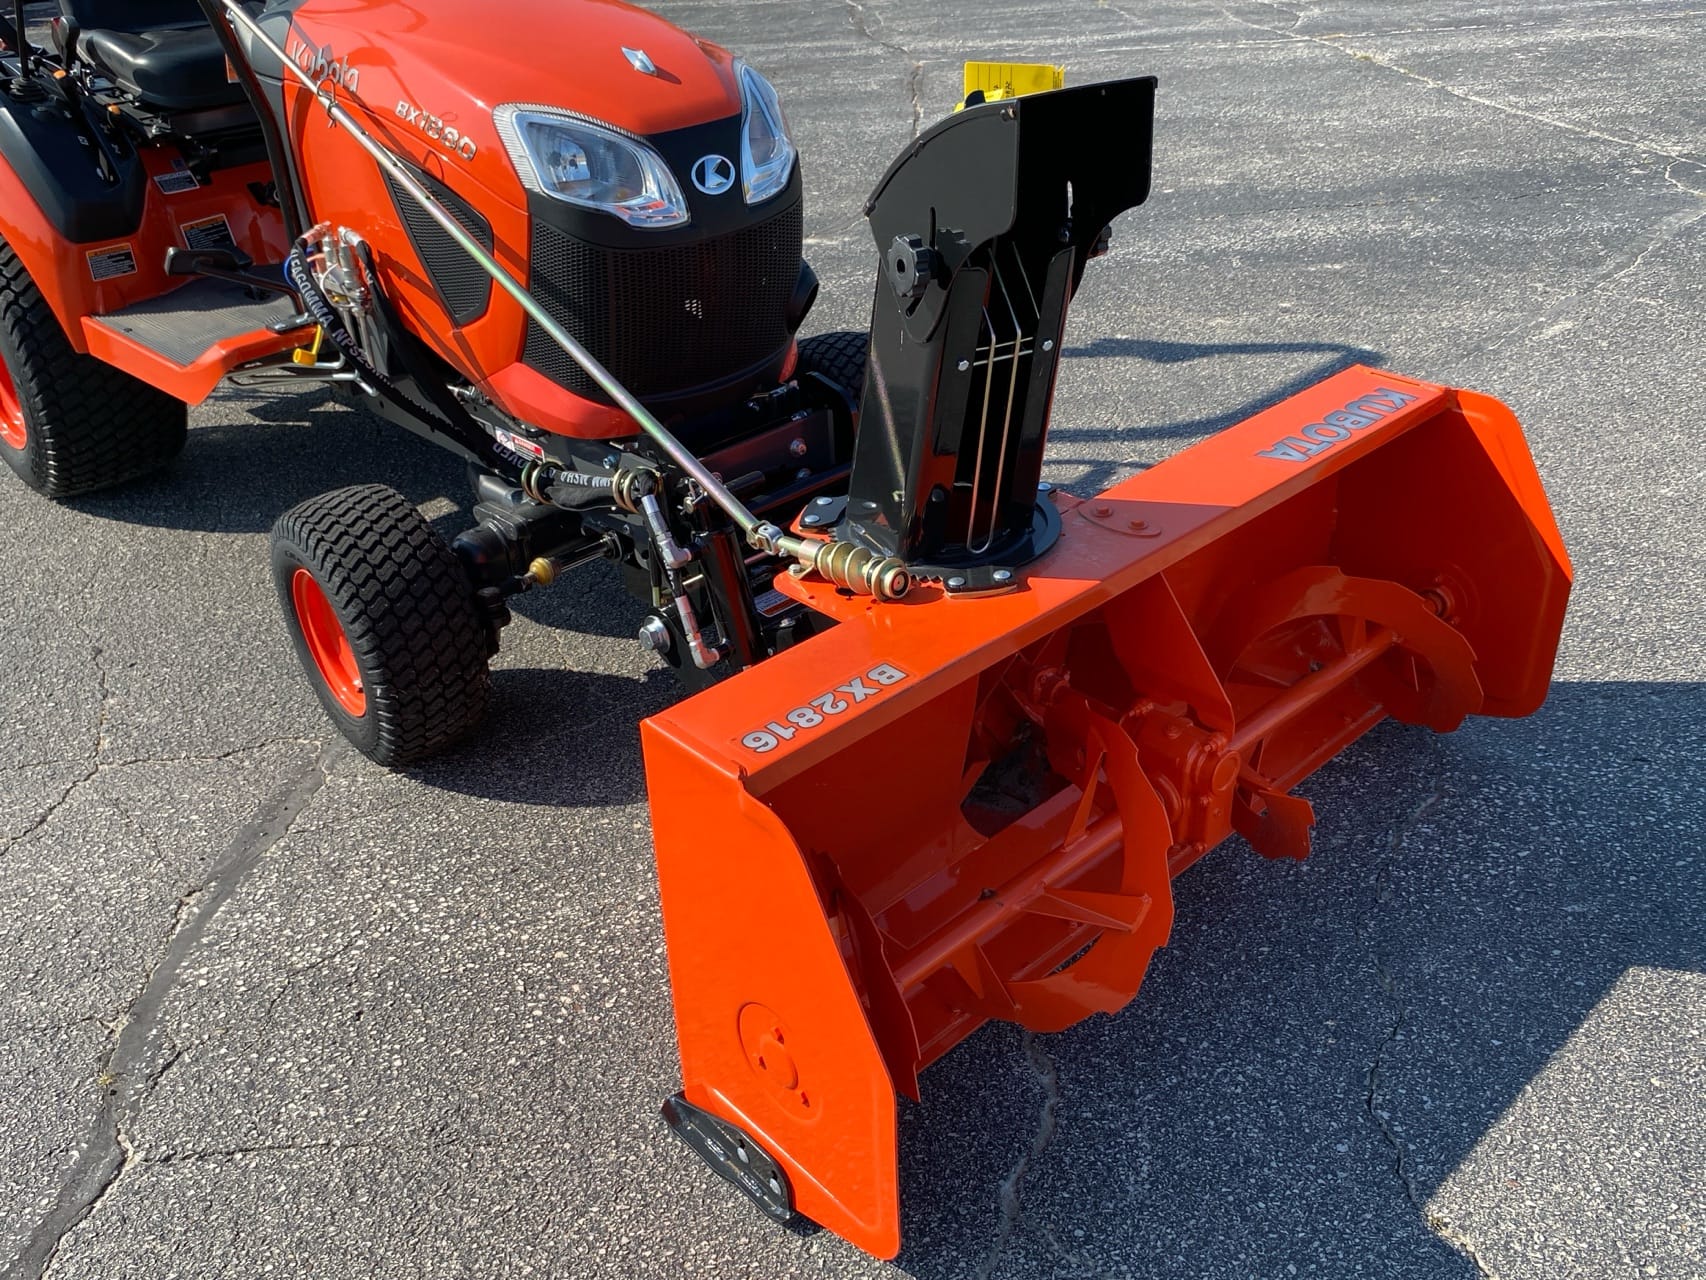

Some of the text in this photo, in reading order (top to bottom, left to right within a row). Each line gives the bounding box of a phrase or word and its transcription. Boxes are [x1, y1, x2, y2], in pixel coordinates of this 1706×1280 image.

[292, 40, 359, 92] Kubota
[395, 99, 477, 161] BX1880
[1255, 387, 1418, 462] KUBOTA
[741, 662, 908, 753] BX2816
